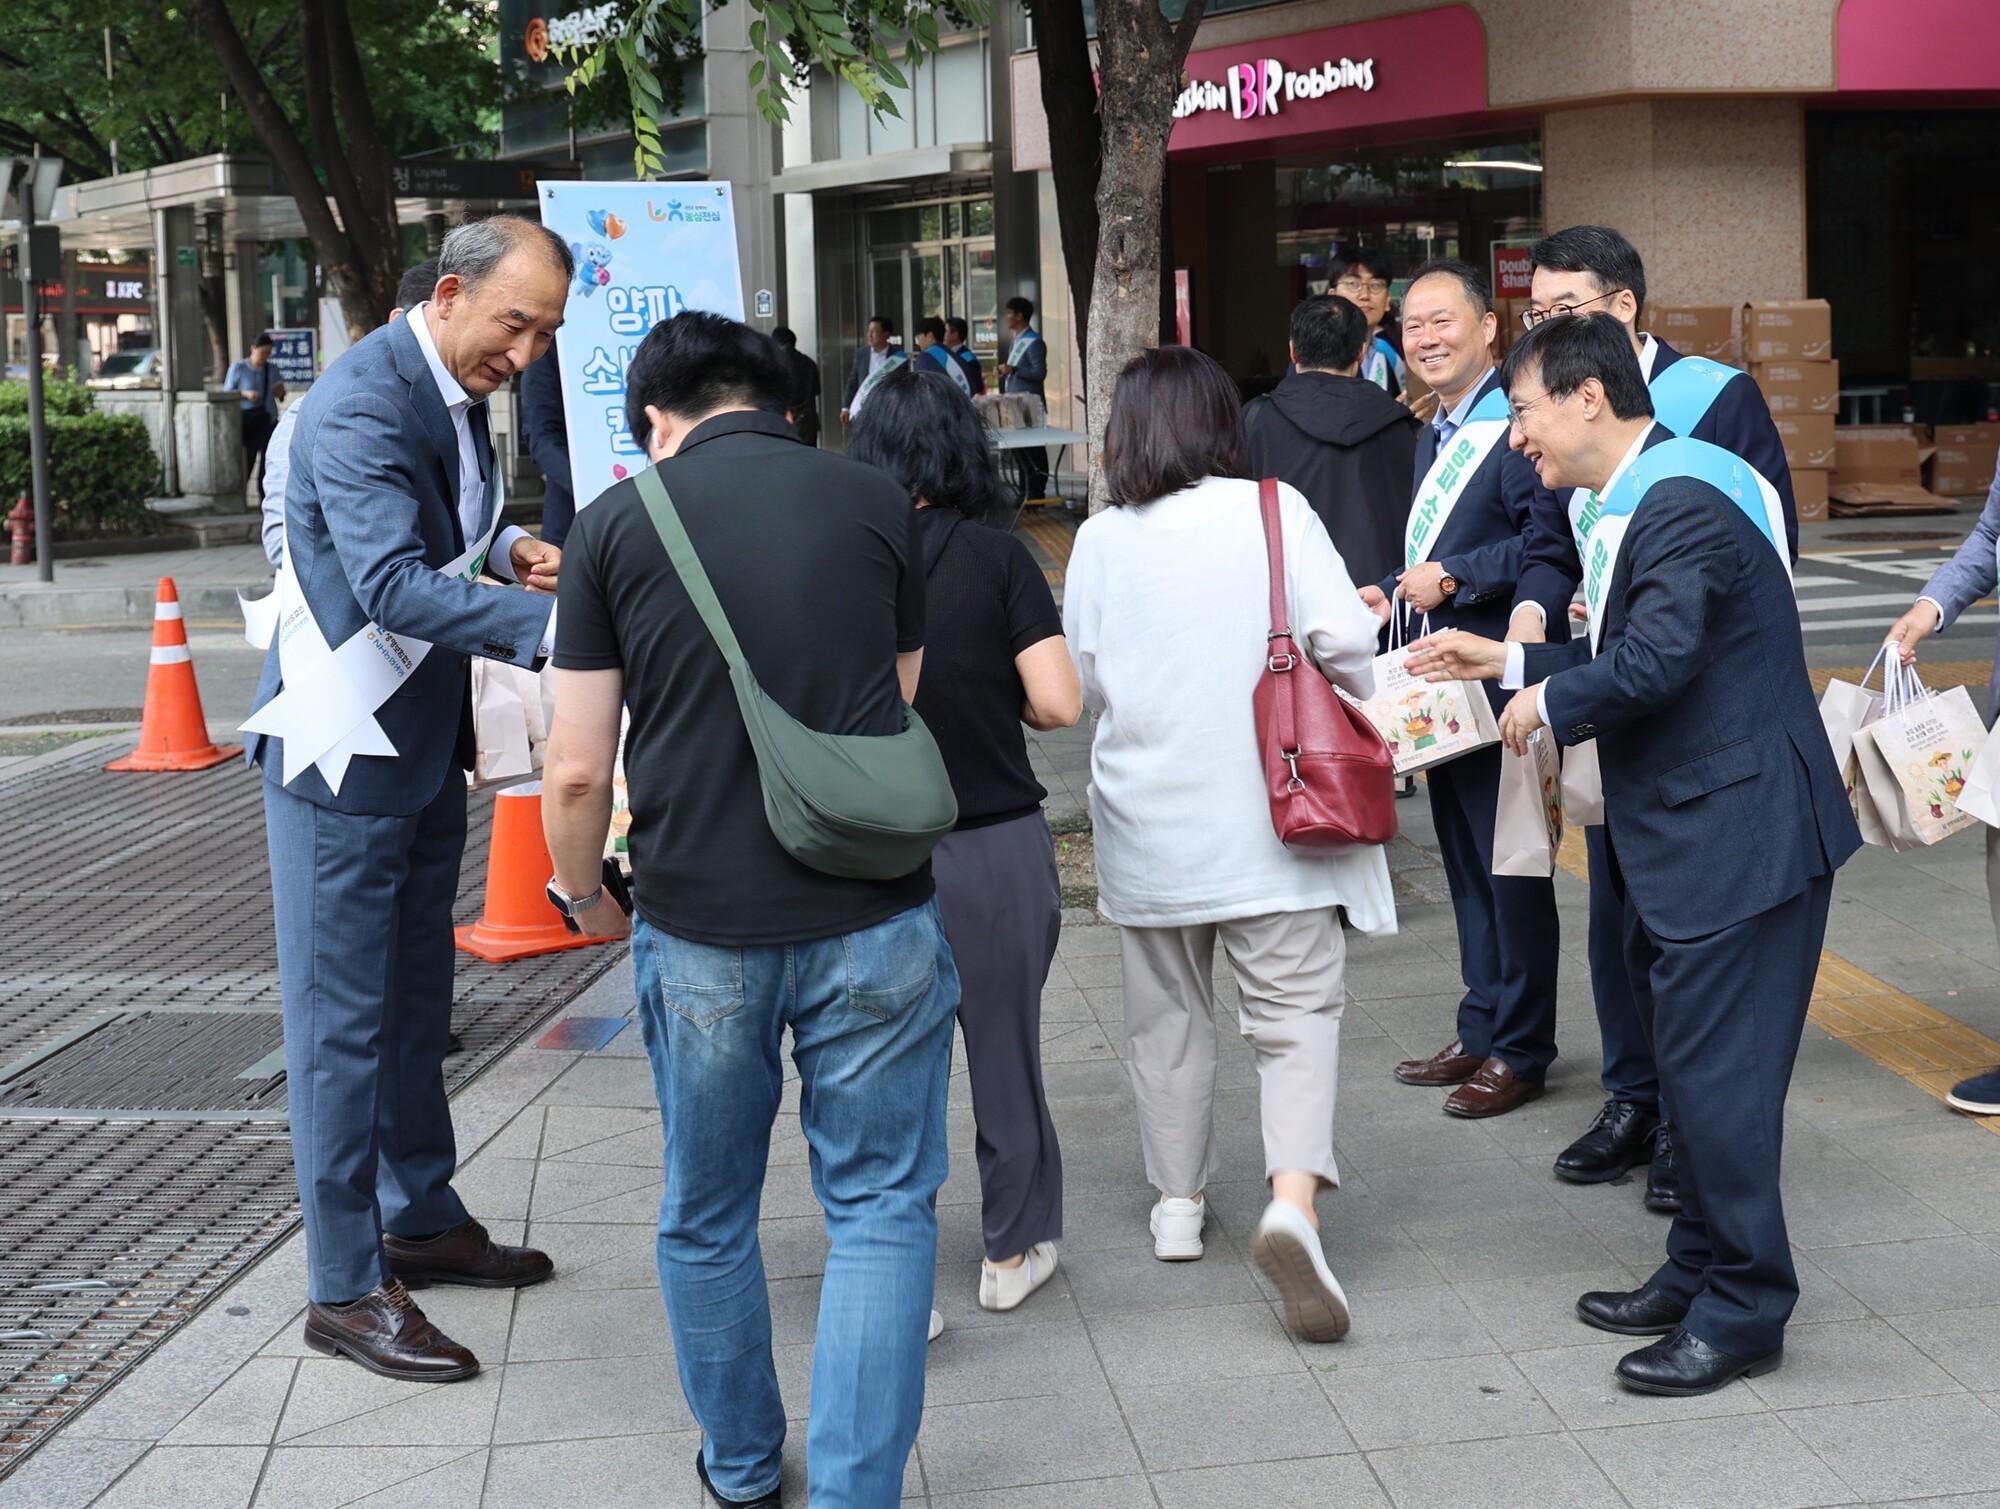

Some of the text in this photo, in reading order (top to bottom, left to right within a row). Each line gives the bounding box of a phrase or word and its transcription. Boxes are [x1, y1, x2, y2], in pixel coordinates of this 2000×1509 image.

[1171, 79, 1227, 118] askin
[1284, 57, 1375, 102] robbins
[117, 281, 144, 299] KFC
[606, 285, 687, 336] 양파
[1435, 438, 1476, 495] 양파
[1587, 537, 1609, 613] 양파
